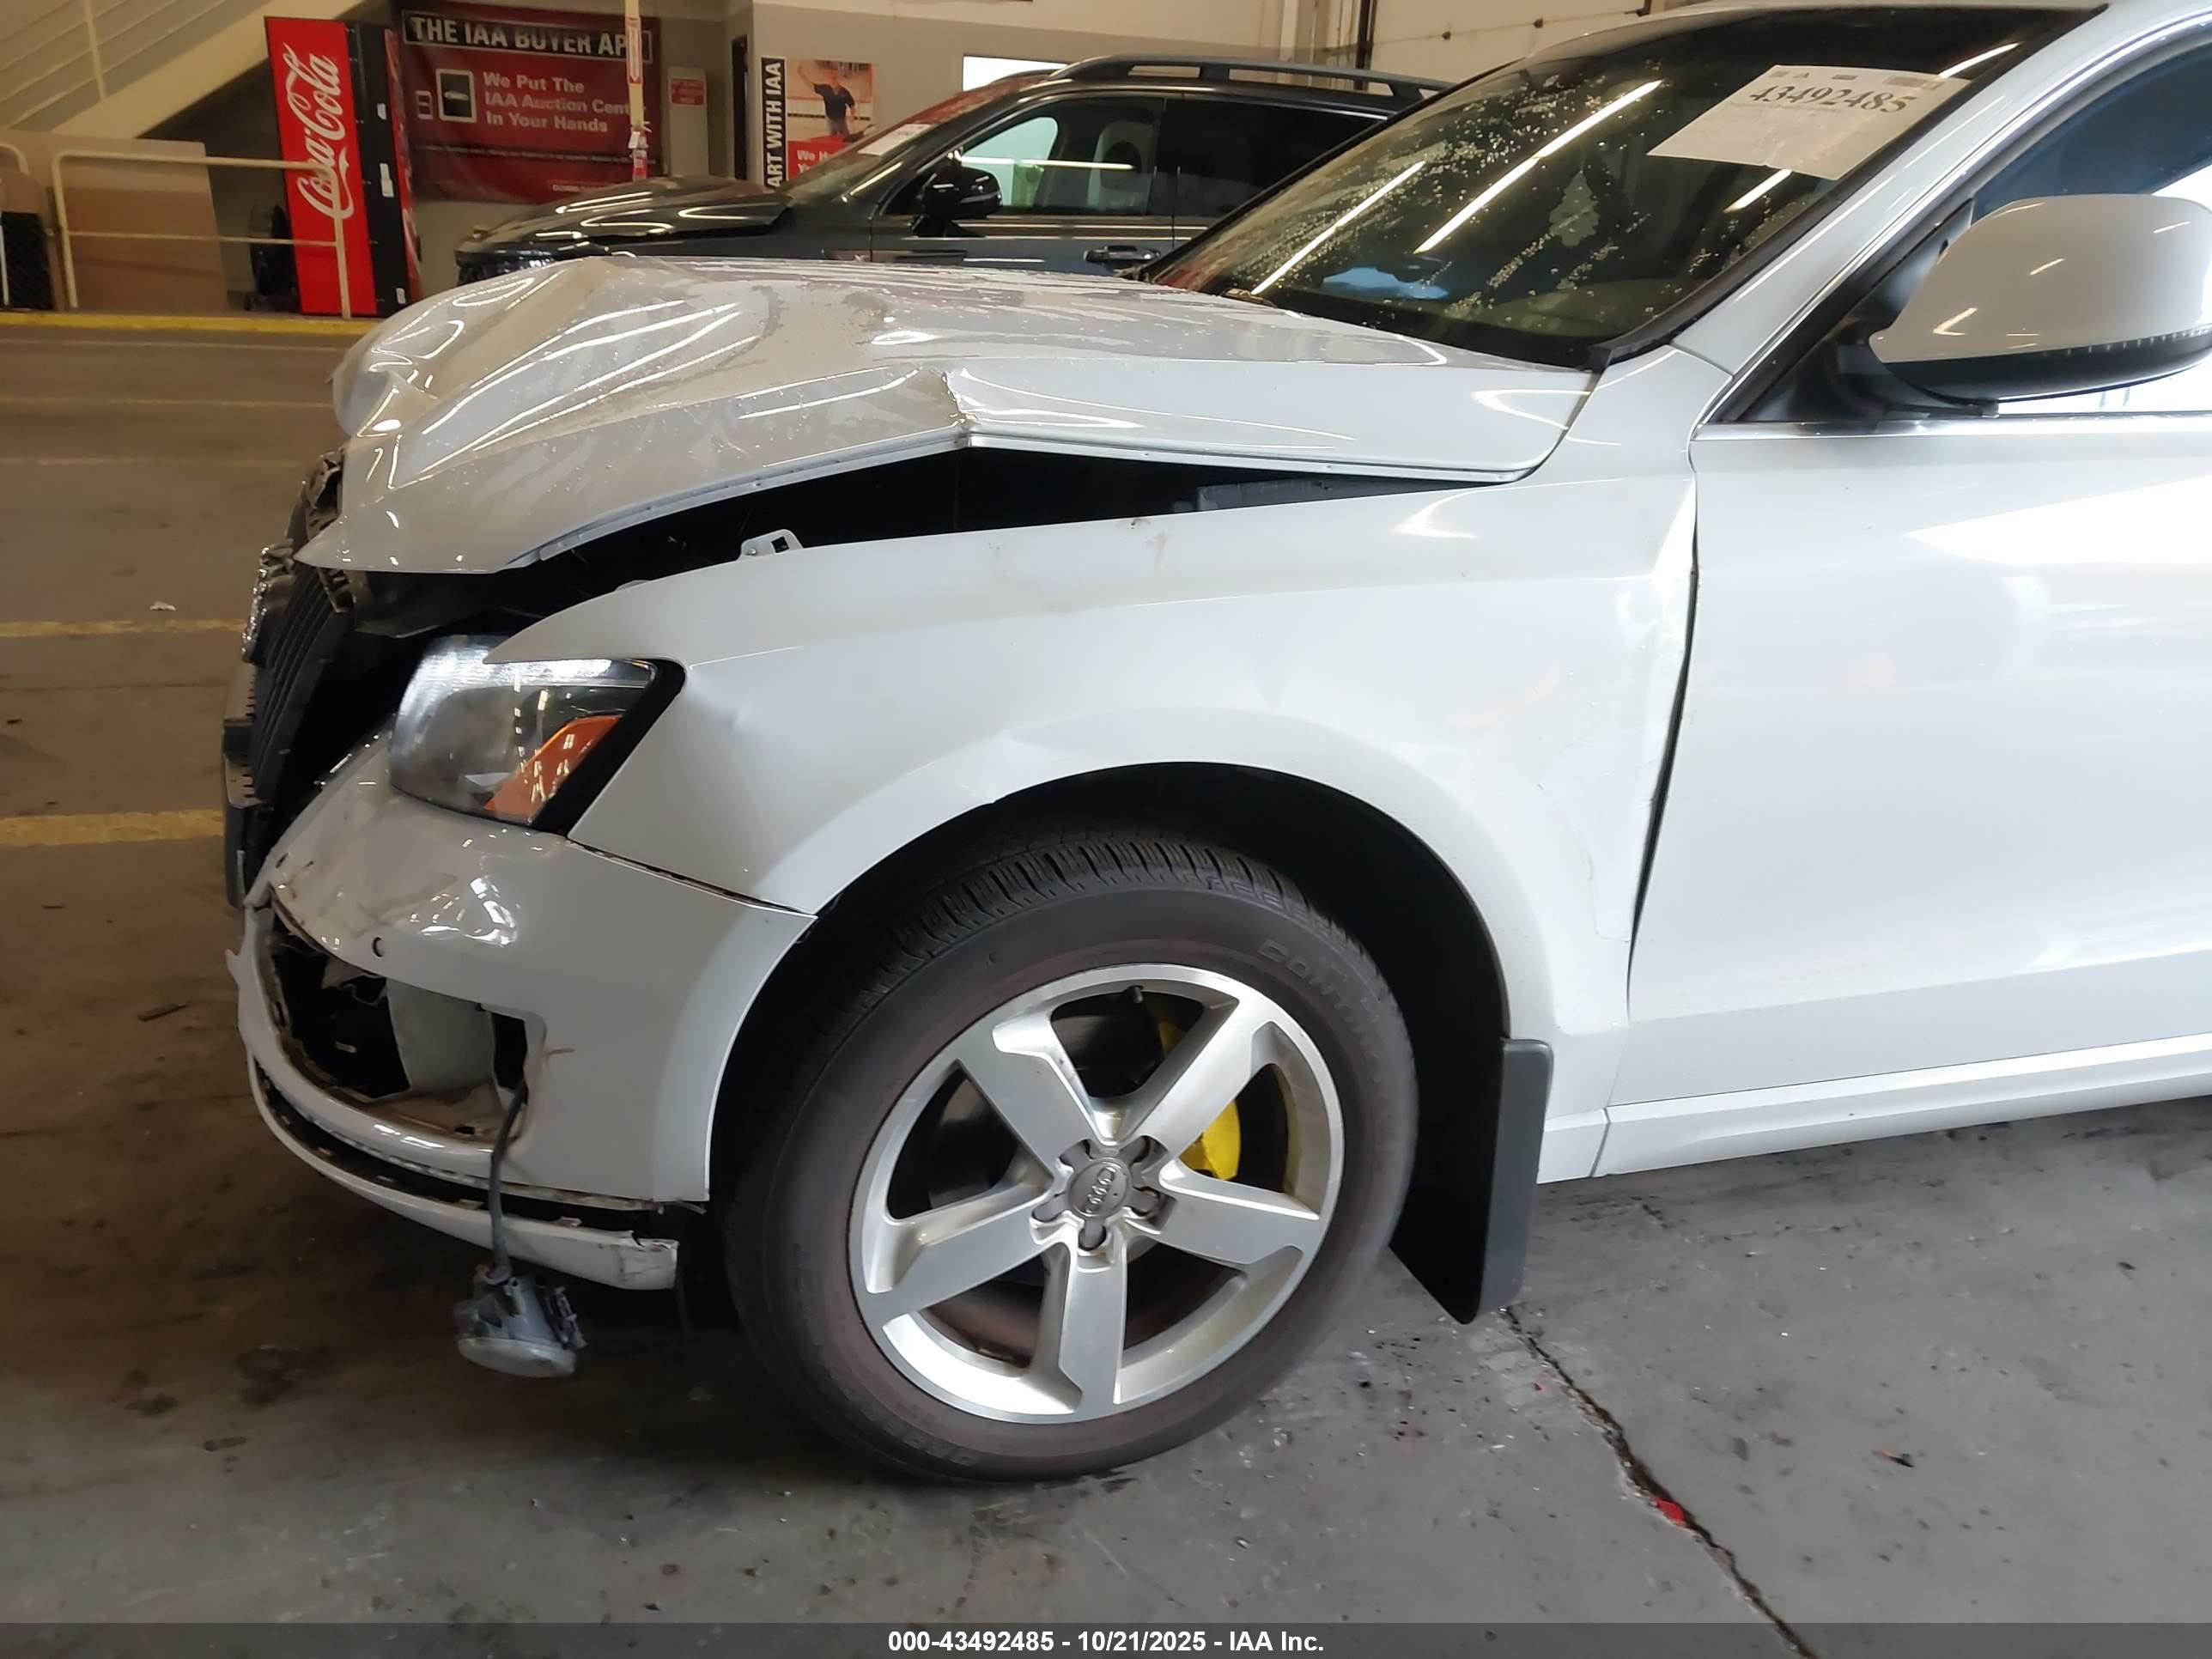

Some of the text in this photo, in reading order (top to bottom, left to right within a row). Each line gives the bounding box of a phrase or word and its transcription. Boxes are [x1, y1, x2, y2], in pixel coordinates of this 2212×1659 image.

[410, 16, 459, 43] THE
[465, 21, 508, 47] IAA
[515, 27, 592, 54] BUYER
[598, 33, 627, 57] AP
[483, 71, 585, 94] We Put The
[764, 62, 782, 95] IAA
[485, 90, 646, 116] IAA Auction Cent
[1748, 84, 1918, 113] 43492485
[282, 41, 356, 221] Coa-Cola
[486, 110, 608, 132] In Your Hands
[765, 100, 783, 149] WITH
[797, 149, 816, 161] We
